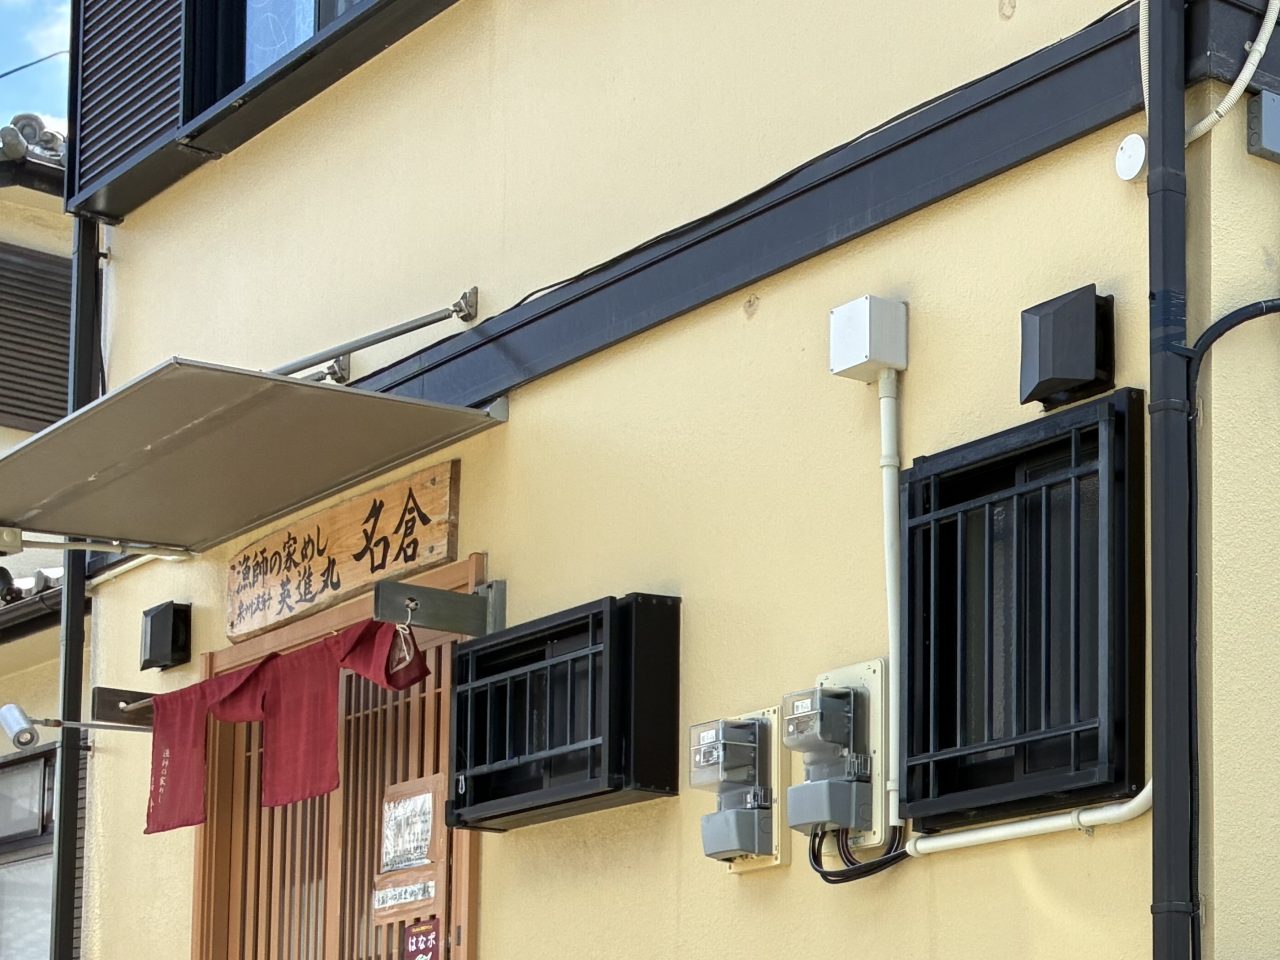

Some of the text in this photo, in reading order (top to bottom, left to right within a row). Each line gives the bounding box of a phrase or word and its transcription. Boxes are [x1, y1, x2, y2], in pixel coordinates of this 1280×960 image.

[236, 525, 328, 595] 漁師の家めし
[352, 487, 432, 574] 名倉
[275, 556, 341, 615] 英進丸
